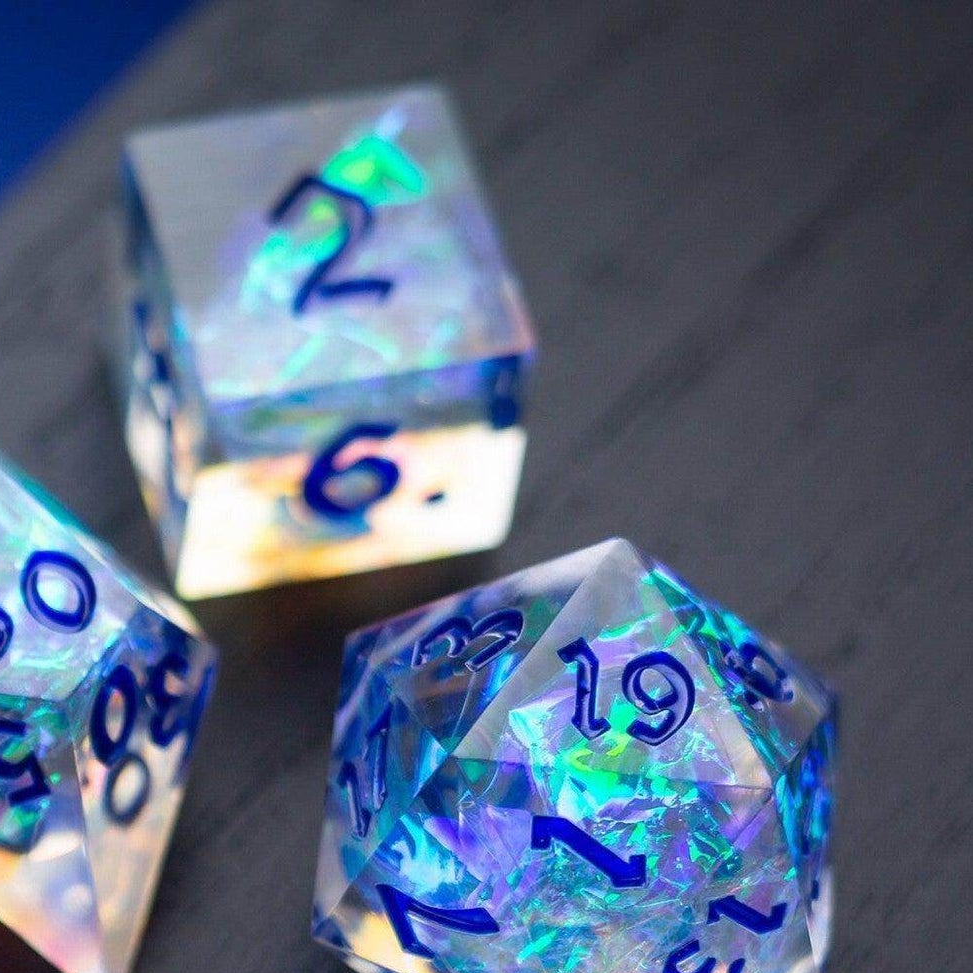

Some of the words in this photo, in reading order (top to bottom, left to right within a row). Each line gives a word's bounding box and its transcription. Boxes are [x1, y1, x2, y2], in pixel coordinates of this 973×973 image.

[265, 170, 393, 318] 2
[557, 637, 696, 746] 19
[530, 815, 647, 889] 1
[376, 884, 500, 961] 7
